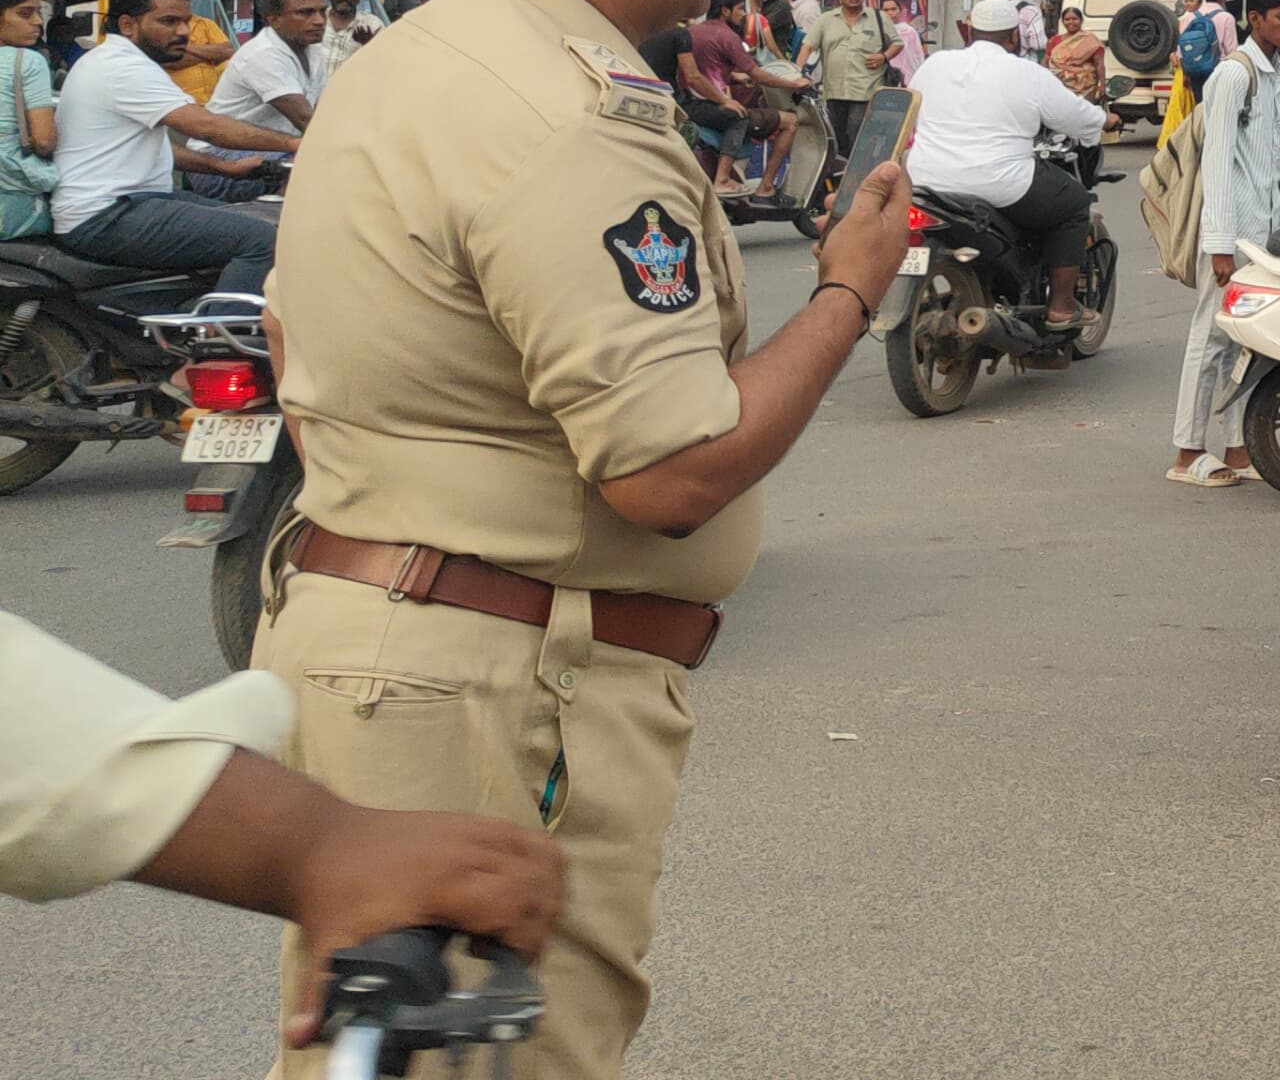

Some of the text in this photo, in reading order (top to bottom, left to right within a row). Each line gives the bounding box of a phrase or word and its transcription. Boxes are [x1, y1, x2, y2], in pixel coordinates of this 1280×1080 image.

[637, 283, 695, 306] POLICE
[205, 418, 267, 437] AP39K
[198, 439, 263, 459] L9087
